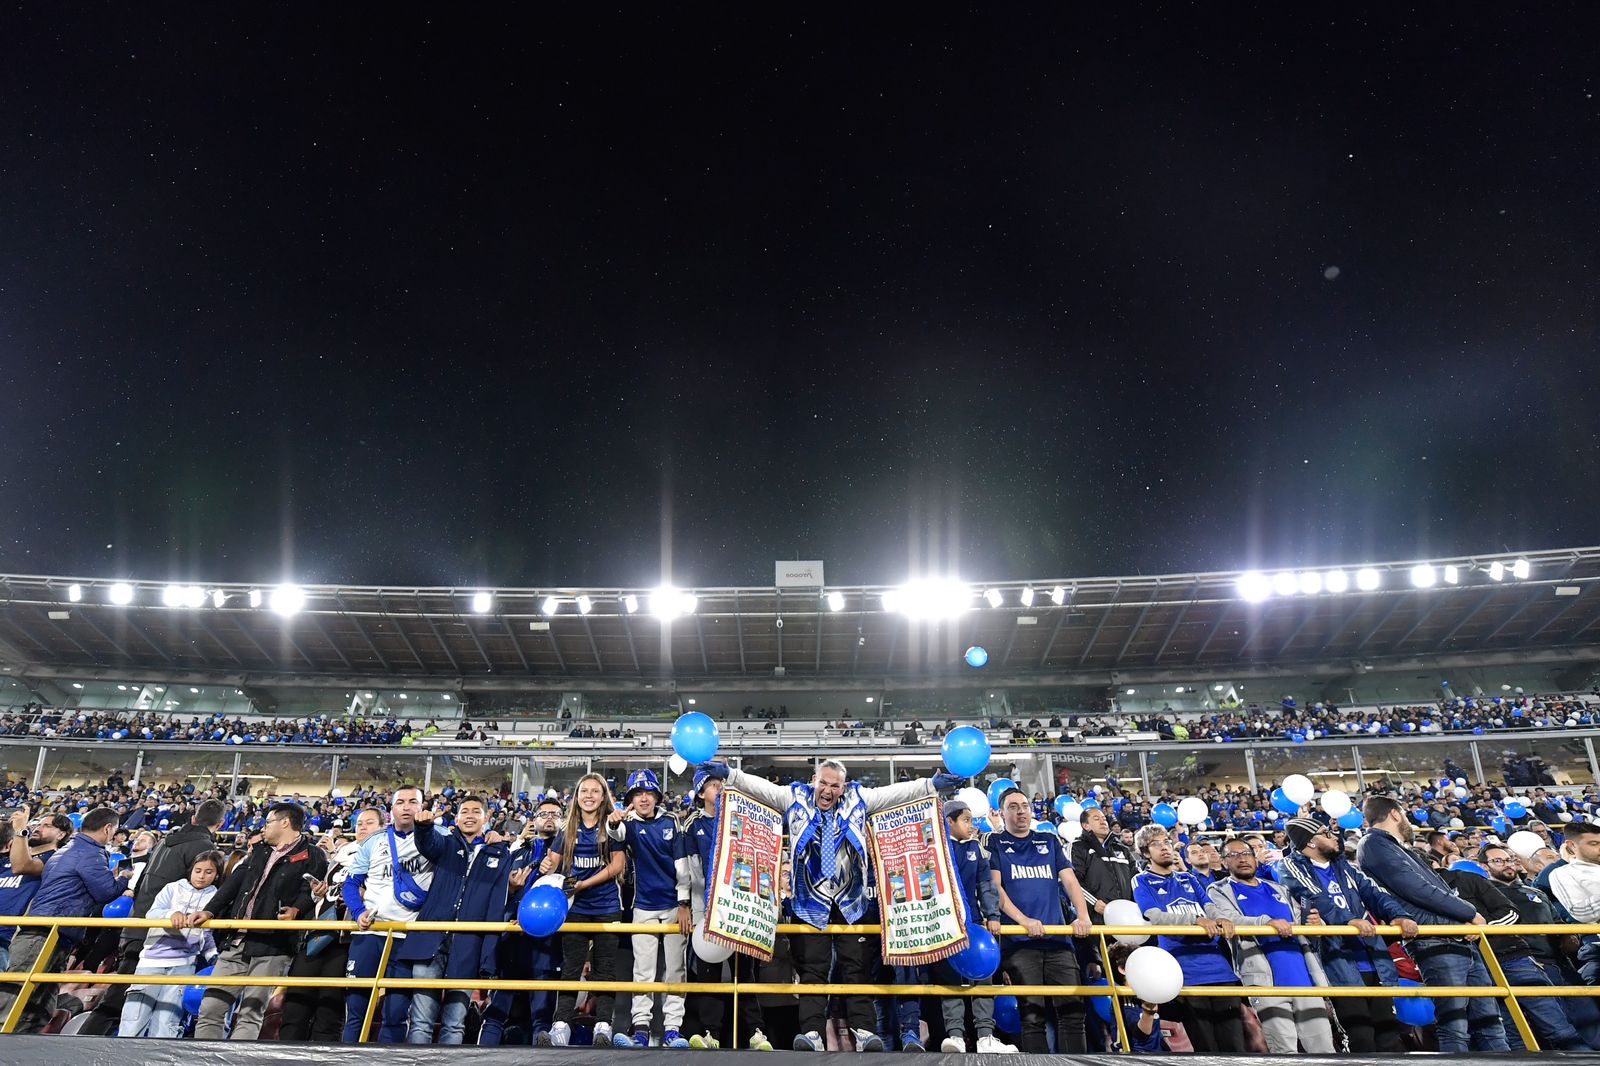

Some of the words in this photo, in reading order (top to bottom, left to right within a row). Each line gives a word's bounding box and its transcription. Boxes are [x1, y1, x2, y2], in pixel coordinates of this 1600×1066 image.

[737, 805, 748, 815] DE
[878, 823, 890, 831] DE
[382, 858, 421, 879] AINA
[574, 855, 604, 868] ANDIN
[1010, 863, 1053, 880] ANDINA
[731, 888, 751, 902] VIVA
[717, 896, 731, 908] EN
[733, 902, 749, 914] LOS
[911, 902, 924, 911] LA
[910, 907, 952, 923] ESTADIOS
[718, 920, 726, 930] Y
[726, 924, 740, 936] DE
[728, 912, 746, 925] DEL
[747, 918, 774, 936] MUNDO
[895, 928, 909, 938] DEL
[910, 922, 941, 936] MUNDO
[888, 941, 895, 949] Y
[896, 940, 909, 950] DE
[908, 932, 954, 948] COLOMBIA
